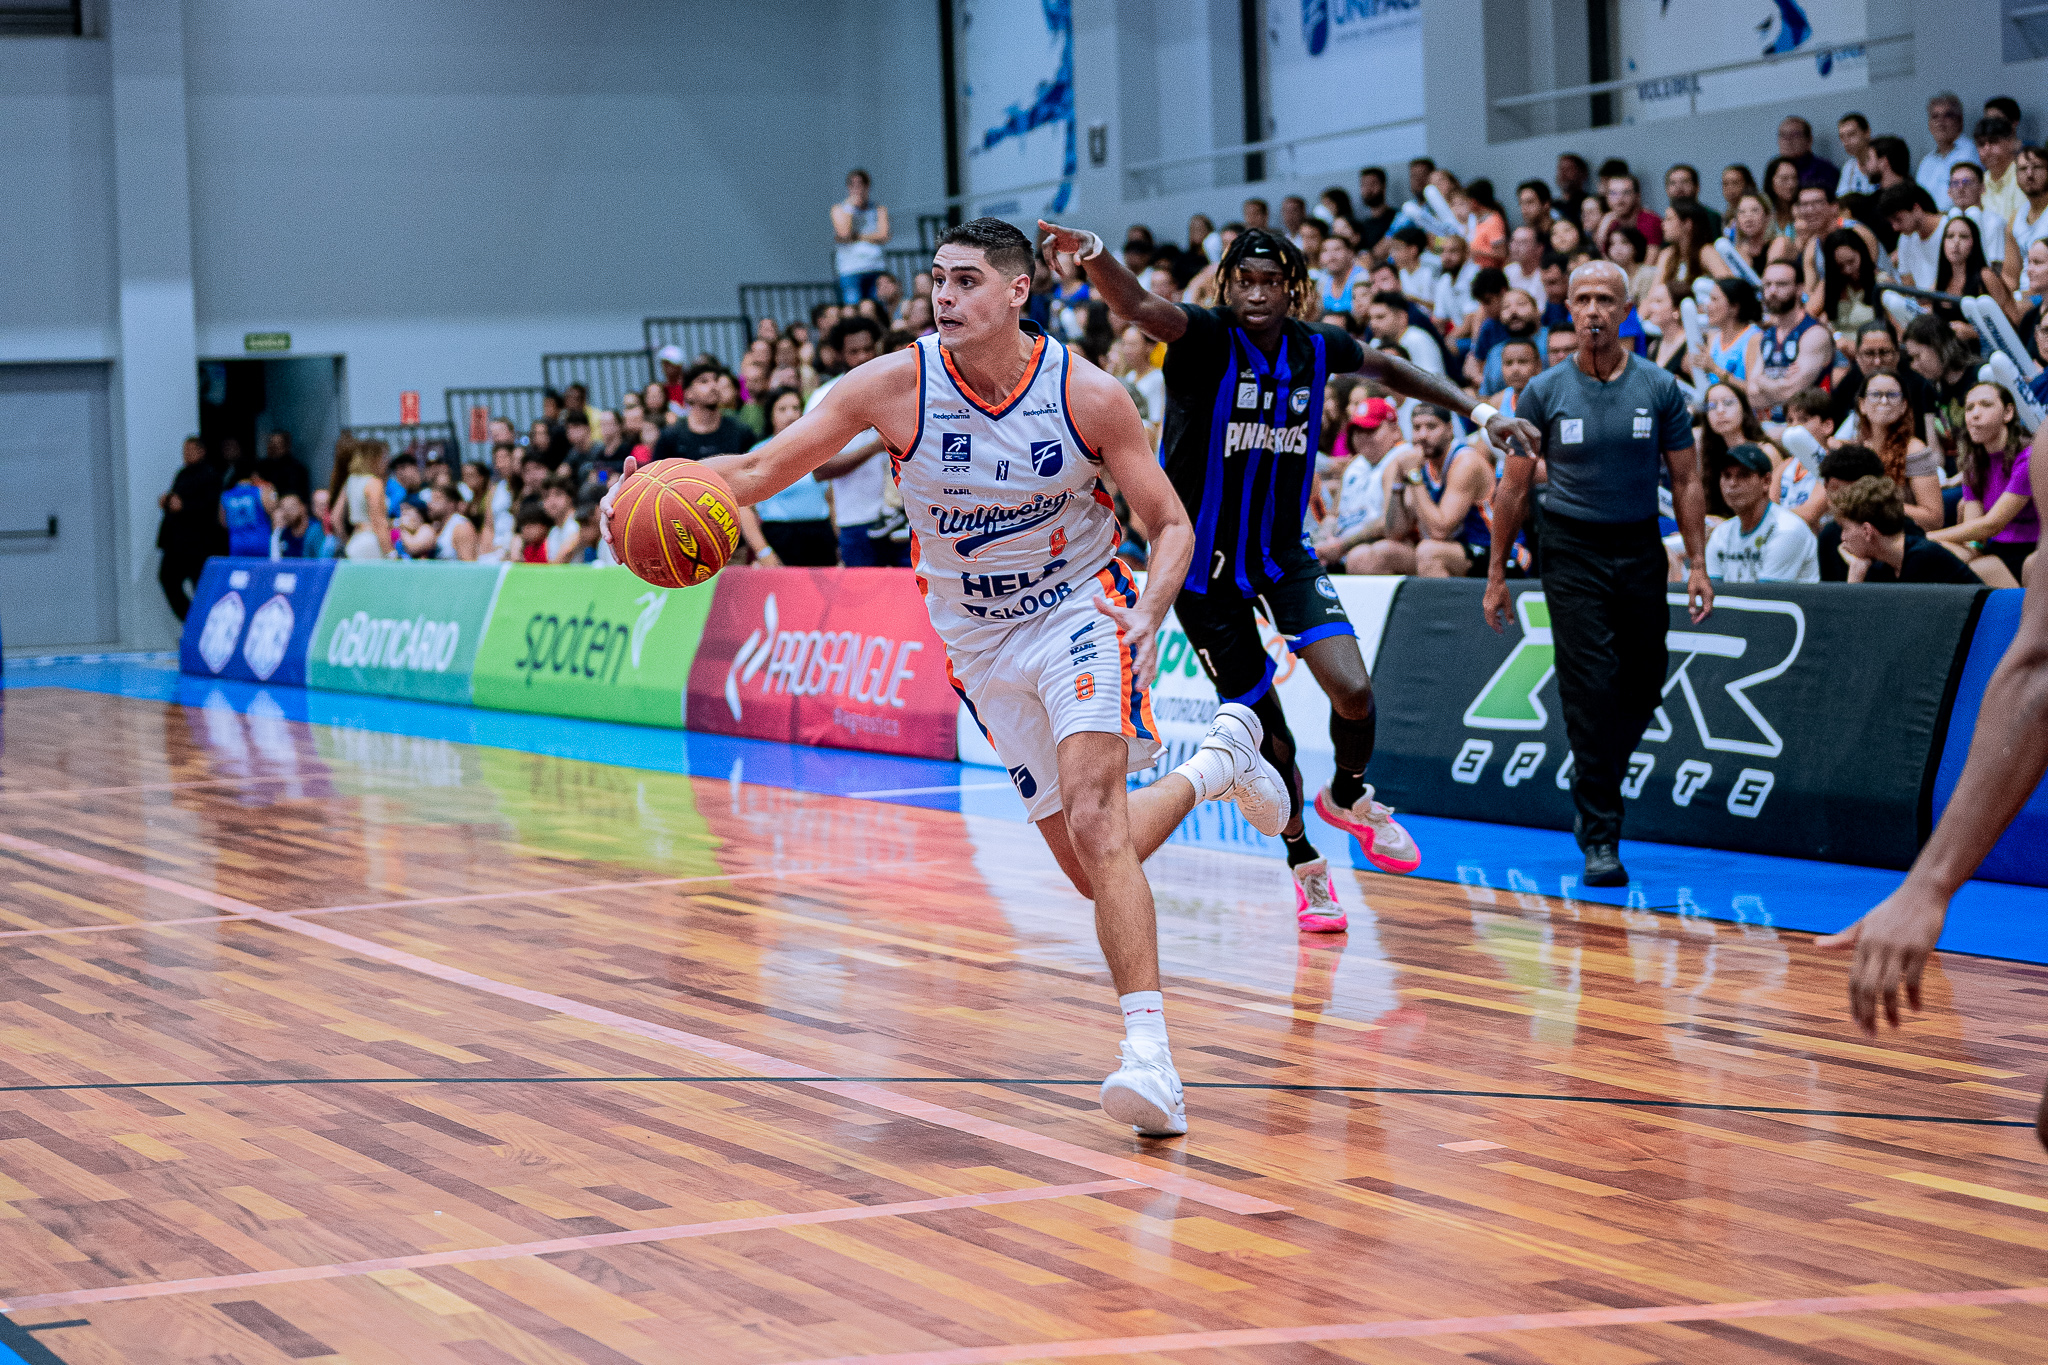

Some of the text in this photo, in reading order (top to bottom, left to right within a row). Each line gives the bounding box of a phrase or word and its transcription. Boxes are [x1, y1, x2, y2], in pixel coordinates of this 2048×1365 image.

[1023, 408, 1058, 417] Redepharma
[1224, 421, 1309, 458] PINHEROS
[762, 630, 924, 708] PROSANGUE
[1074, 672, 1096, 702] 8
